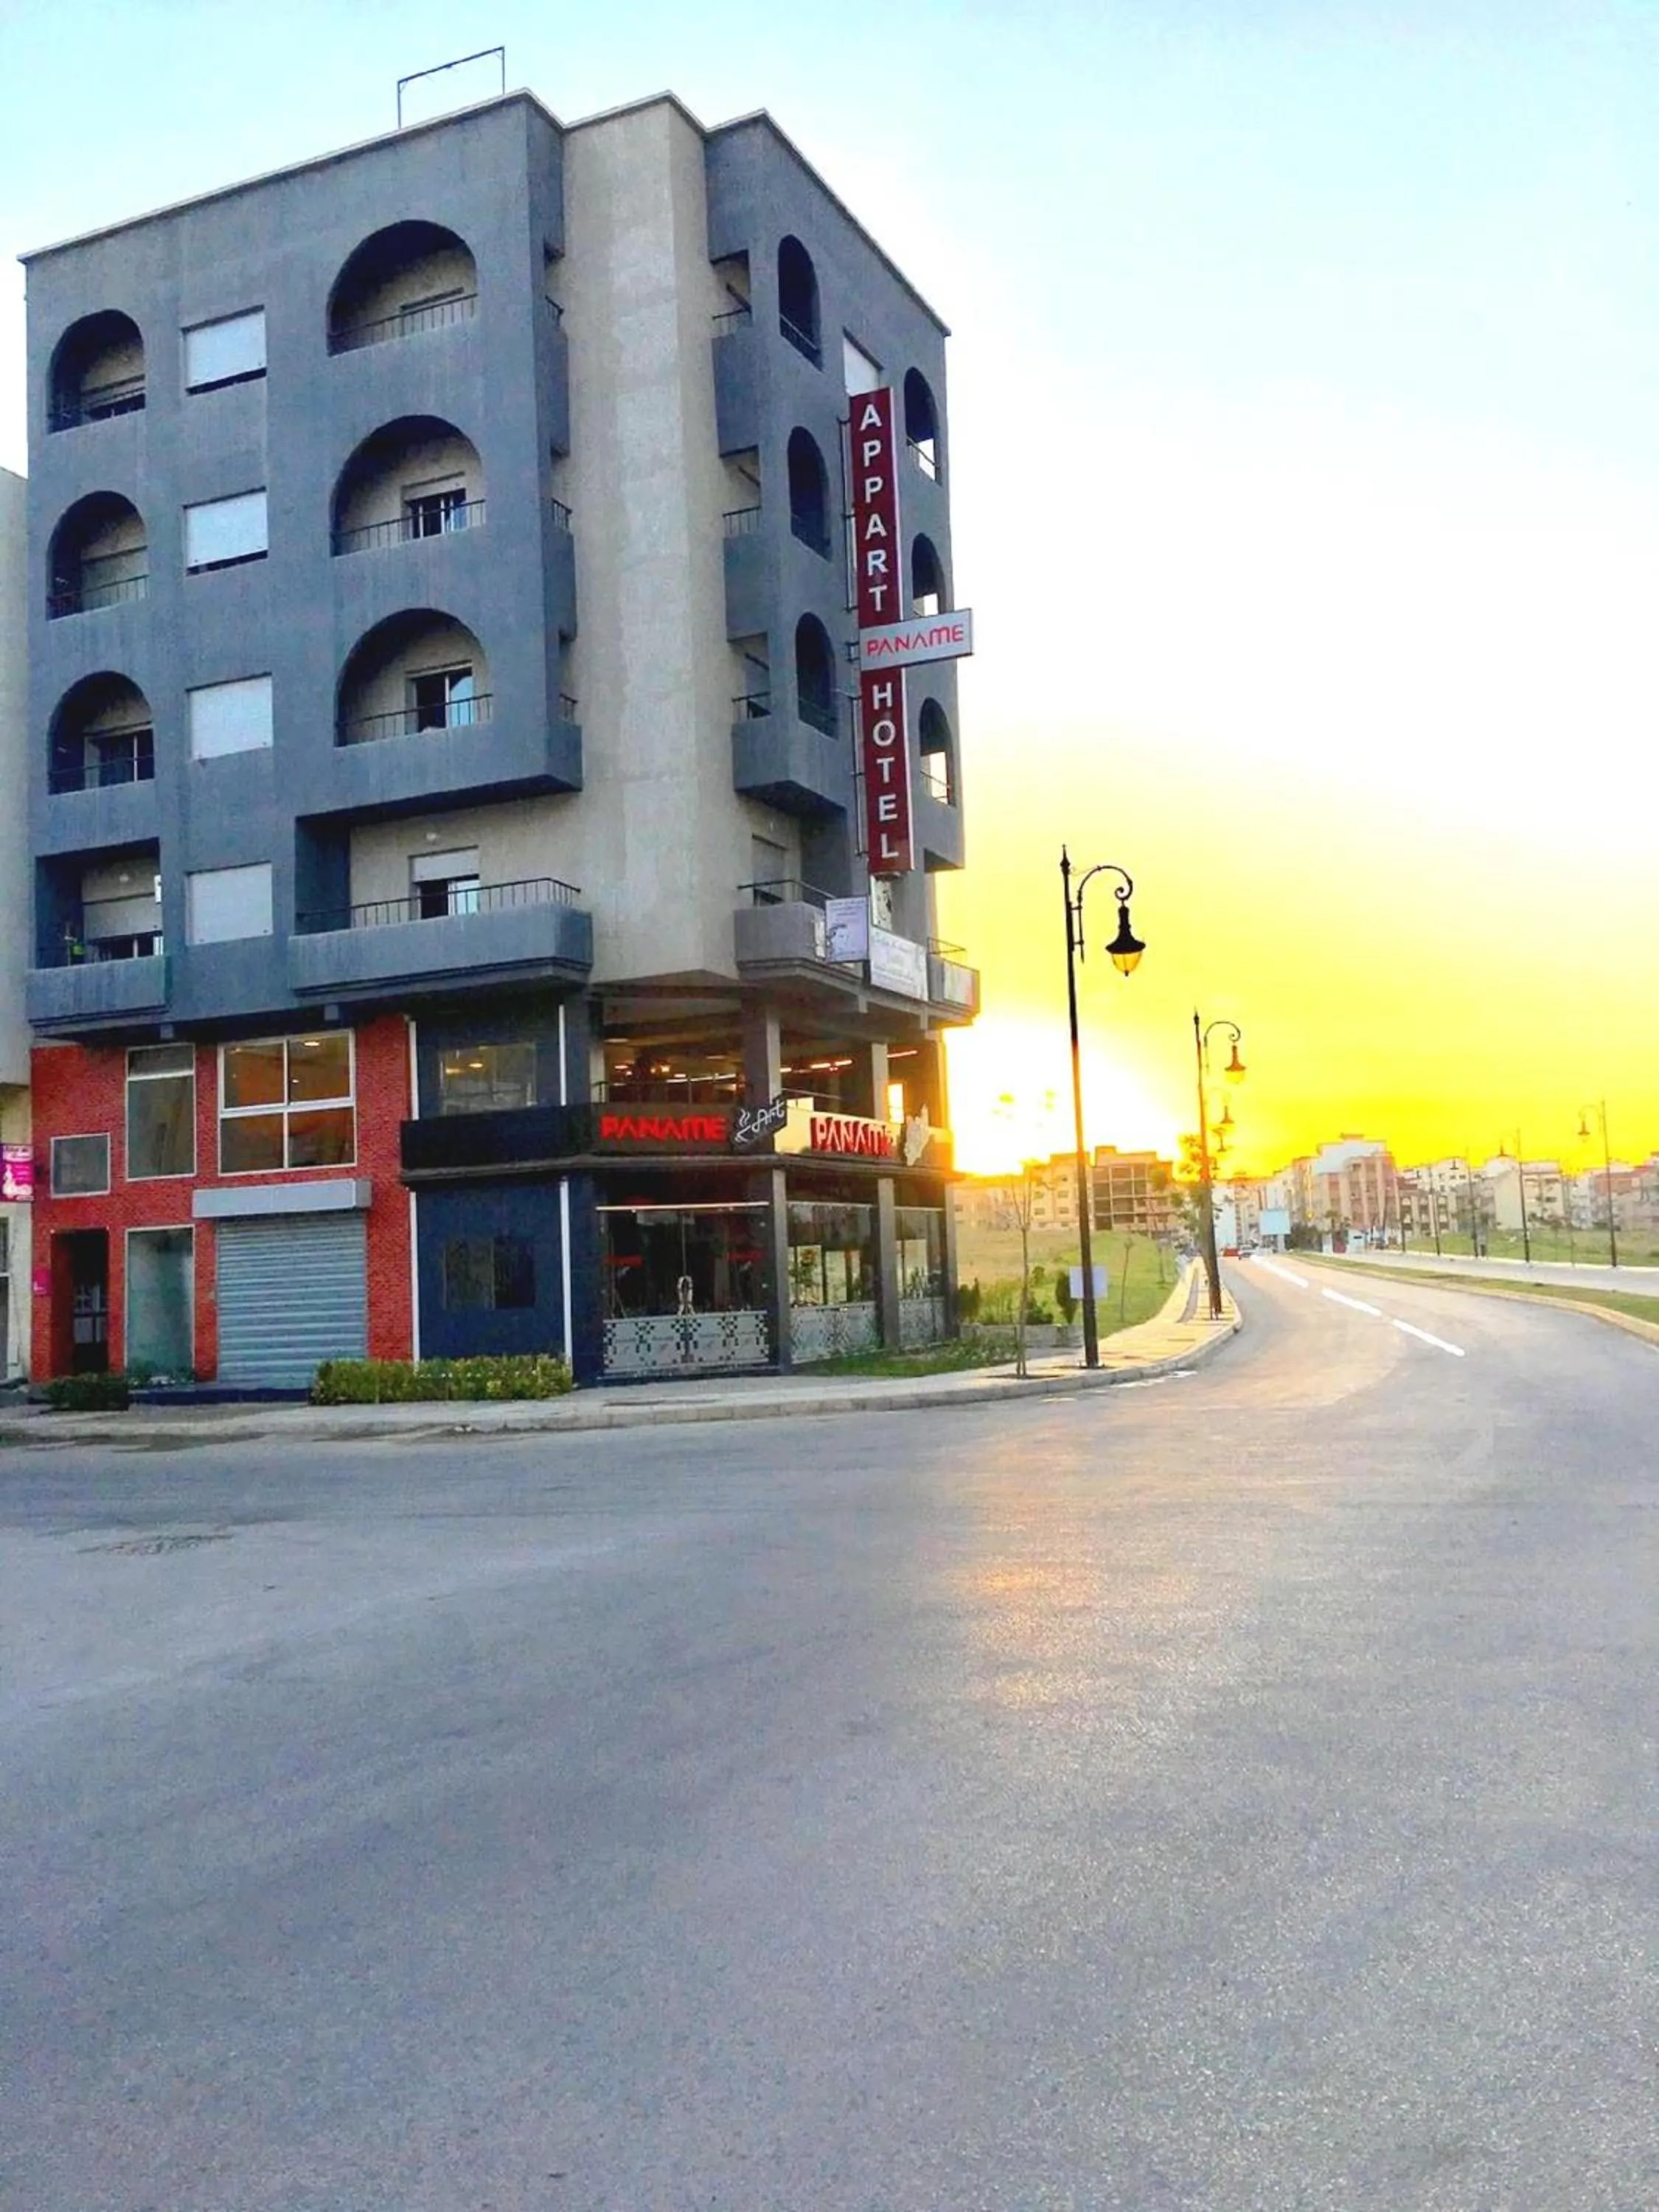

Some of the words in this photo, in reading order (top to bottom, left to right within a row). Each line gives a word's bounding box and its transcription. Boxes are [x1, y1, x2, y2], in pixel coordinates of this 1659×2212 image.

[860, 403, 888, 613] APPART
[867, 624, 964, 656] PANAME
[872, 681, 899, 860] HOTEL
[601, 1114, 727, 1141] PANAME
